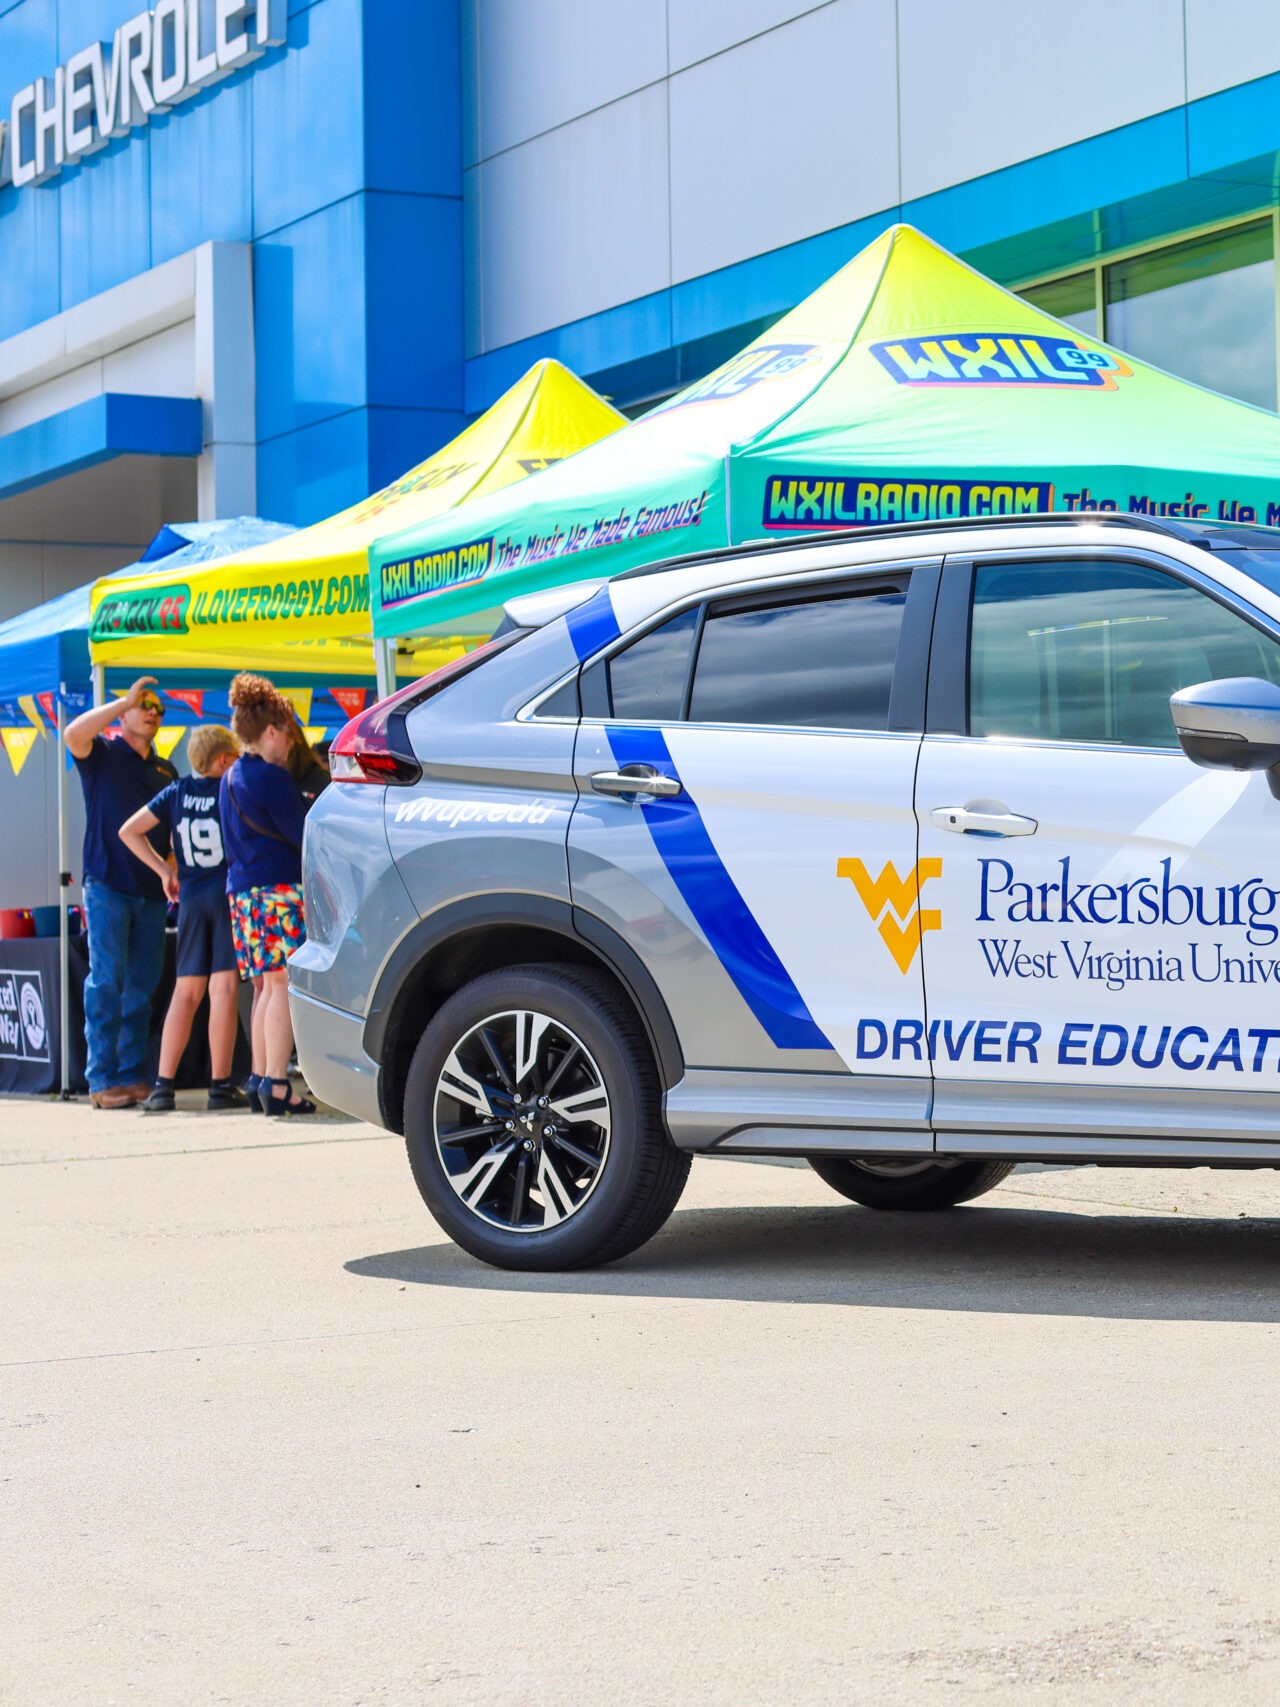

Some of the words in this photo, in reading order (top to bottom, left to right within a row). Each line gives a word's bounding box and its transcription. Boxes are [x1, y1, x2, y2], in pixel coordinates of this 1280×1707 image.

[884, 338, 1090, 382] WXIL
[1067, 349, 1109, 369] 99
[770, 480, 1039, 521] WXILRADIOCOM
[1217, 500, 1257, 524] We
[382, 542, 489, 601] WXILRADIO.COM
[495, 537, 522, 572] The
[519, 525, 564, 567] Music
[561, 524, 588, 558] We
[584, 508, 632, 551] Made
[629, 490, 708, 540] Famous!
[159, 596, 185, 629] 95
[192, 574, 370, 625] ILOVEFROGGY.COM
[183, 794, 216, 811] WVUP
[394, 798, 557, 828] wvup.edu
[176, 817, 224, 868] 19
[976, 938, 1058, 980] West
[1060, 940, 1185, 991] Virginia
[856, 1018, 1050, 1065] DRIVER
